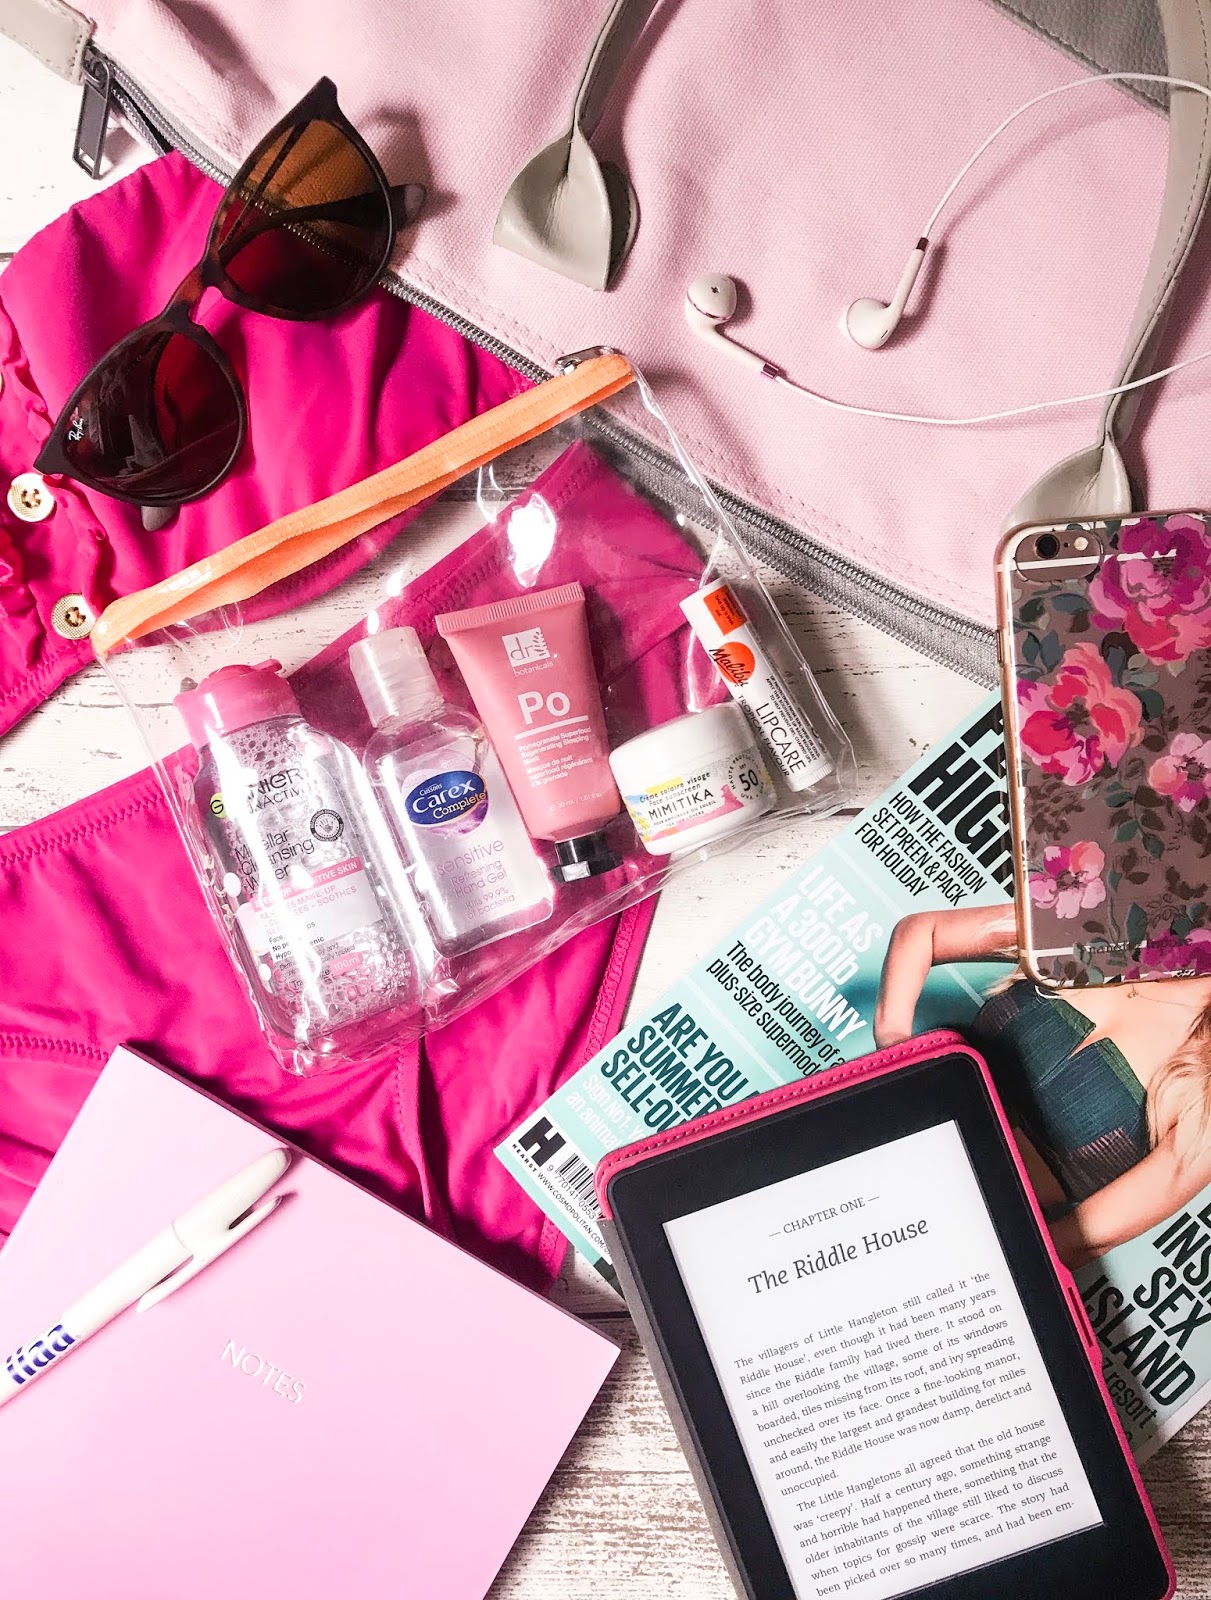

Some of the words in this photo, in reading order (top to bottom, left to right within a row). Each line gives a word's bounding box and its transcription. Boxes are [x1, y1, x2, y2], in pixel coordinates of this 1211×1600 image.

[513, 660, 554, 677] botanicals
[709, 648, 749, 687] Malibu
[517, 690, 571, 725] Po
[560, 726, 592, 742] Superfood
[563, 735, 590, 748] Sleeping
[738, 694, 765, 738] TROPICAL
[763, 737, 790, 777] FLAVOUR
[755, 702, 807, 774] LIPCARE
[560, 755, 573, 763] nuit
[412, 779, 476, 813] Carex
[419, 783, 443, 797] Cussons
[660, 782, 684, 796] solaire
[686, 771, 711, 784] visage
[739, 769, 759, 792] 50
[432, 791, 487, 819] Complete
[648, 788, 714, 820] MIMITIKA
[872, 807, 902, 834] SET
[854, 822, 885, 853] FOR
[876, 843, 930, 897] HOLIDAY
[888, 791, 925, 825] HOW
[916, 817, 945, 848] THE
[935, 839, 988, 895] FASHION
[893, 827, 934, 869] PREEN
[337, 862, 358, 876] SKIN
[450, 859, 503, 886] Refreshing
[454, 878, 485, 898] Hand
[487, 871, 508, 884] Gel
[923, 861, 940, 879] &
[317, 886, 357, 907] SOOTHES
[465, 896, 483, 911] Kills
[466, 909, 478, 920] of
[479, 894, 515, 915] bacteria
[931, 870, 969, 907] PACK
[798, 865, 857, 924] LIFE
[837, 911, 884, 952] AS
[769, 893, 801, 925] A
[788, 908, 859, 986] 300lb
[706, 957, 763, 1018] plus-size
[745, 916, 804, 978] GYM
[783, 959, 868, 1042] BUNNY
[727, 940, 754, 972] The
[747, 963, 784, 1003] body
[773, 995, 826, 1049] journey
[818, 1043, 841, 1063] of
[651, 1002, 709, 1059] ARE
[693, 1042, 749, 1101] YOU
[565, 1091, 586, 1113] an
[582, 1074, 611, 1108] Sign
[511, 1143, 537, 1173] HEARST
[518, 1116, 567, 1167] H
[546, 1164, 554, 1172] 9
[554, 1171, 579, 1200] 770141
[783, 1207, 839, 1235] CHAPTER
[839, 1197, 866, 1214] ONE
[747, 1269, 789, 1294] The
[793, 1243, 858, 1279] Riddle
[862, 1219, 929, 1254] House
[733, 1357, 754, 1369] The
[757, 1340, 800, 1361] villagers
[803, 1332, 814, 1345] of
[817, 1324, 844, 1340] Little
[847, 1306, 899, 1329] Hangleton
[902, 1295, 922, 1310] still
[925, 1283, 955, 1301] called
[958, 1280, 968, 1290] it
[1132, 1266, 1211, 1351] SEX
[739, 1368, 771, 1385] Riddle
[813, 1345, 838, 1359] even
[839, 1330, 876, 1350] though
[877, 1326, 887, 1336] it
[888, 1317, 909, 1332] had
[910, 1310, 936, 1324] been
[938, 1298, 966, 1315] many
[969, 1288, 997, 1306] years
[745, 1386, 772, 1401] since
[774, 1379, 792, 1390] the
[794, 1366, 826, 1384] Riddle
[828, 1354, 860, 1372] family
[863, 1344, 884, 1359] had
[885, 1334, 912, 1351] lived
[913, 1326, 943, 1341] there.
[945, 1320, 956, 1330] It
[957, 1308, 986, 1326] stood
[988, 1304, 1003, 1314] on
[1081, 1274, 1197, 1406] ISLAND
[219, 1338, 307, 1404] NOTES
[751, 1409, 759, 1417] a
[761, 1399, 780, 1413] hill
[782, 1379, 841, 1406] overlooking
[842, 1373, 860, 1384] the
[862, 1360, 899, 1377] village,
[901, 1348, 929, 1364] some
[932, 1340, 944, 1352] of
[946, 1337, 960, 1348] its
[962, 1319, 1009, 1341] windows
[756, 1410, 801, 1432] boarded,
[800, 1403, 823, 1417] tiles
[823, 1389, 864, 1409] missing
[863, 1381, 889, 1395] from
[889, 1375, 903, 1386] its
[903, 1365, 928, 1381] roof,
[928, 1357, 949, 1372] and
[948, 1353, 964, 1365] ivy
[965, 1335, 1016, 1360] spreading
[762, 1422, 816, 1448] unchecked
[818, 1415, 840, 1429] over
[842, 1410, 857, 1420] its
[858, 1401, 883, 1415] face.
[885, 1390, 911, 1405] Once
[913, 1387, 921, 1395] a
[923, 1365, 983, 1392] fine-looking
[984, 1352, 1021, 1370] manor,
[769, 1449, 789, 1465] and
[789, 1441, 818, 1457] easily
[819, 1435, 837, 1446] the
[837, 1421, 873, 1440] largest
[874, 1412, 894, 1427] and
[895, 1398, 939, 1422] grandest
[938, 1383, 982, 1404] building
[981, 1378, 997, 1389] for
[998, 1368, 1027, 1383] miles
[1105, 1372, 1158, 1430] resort
